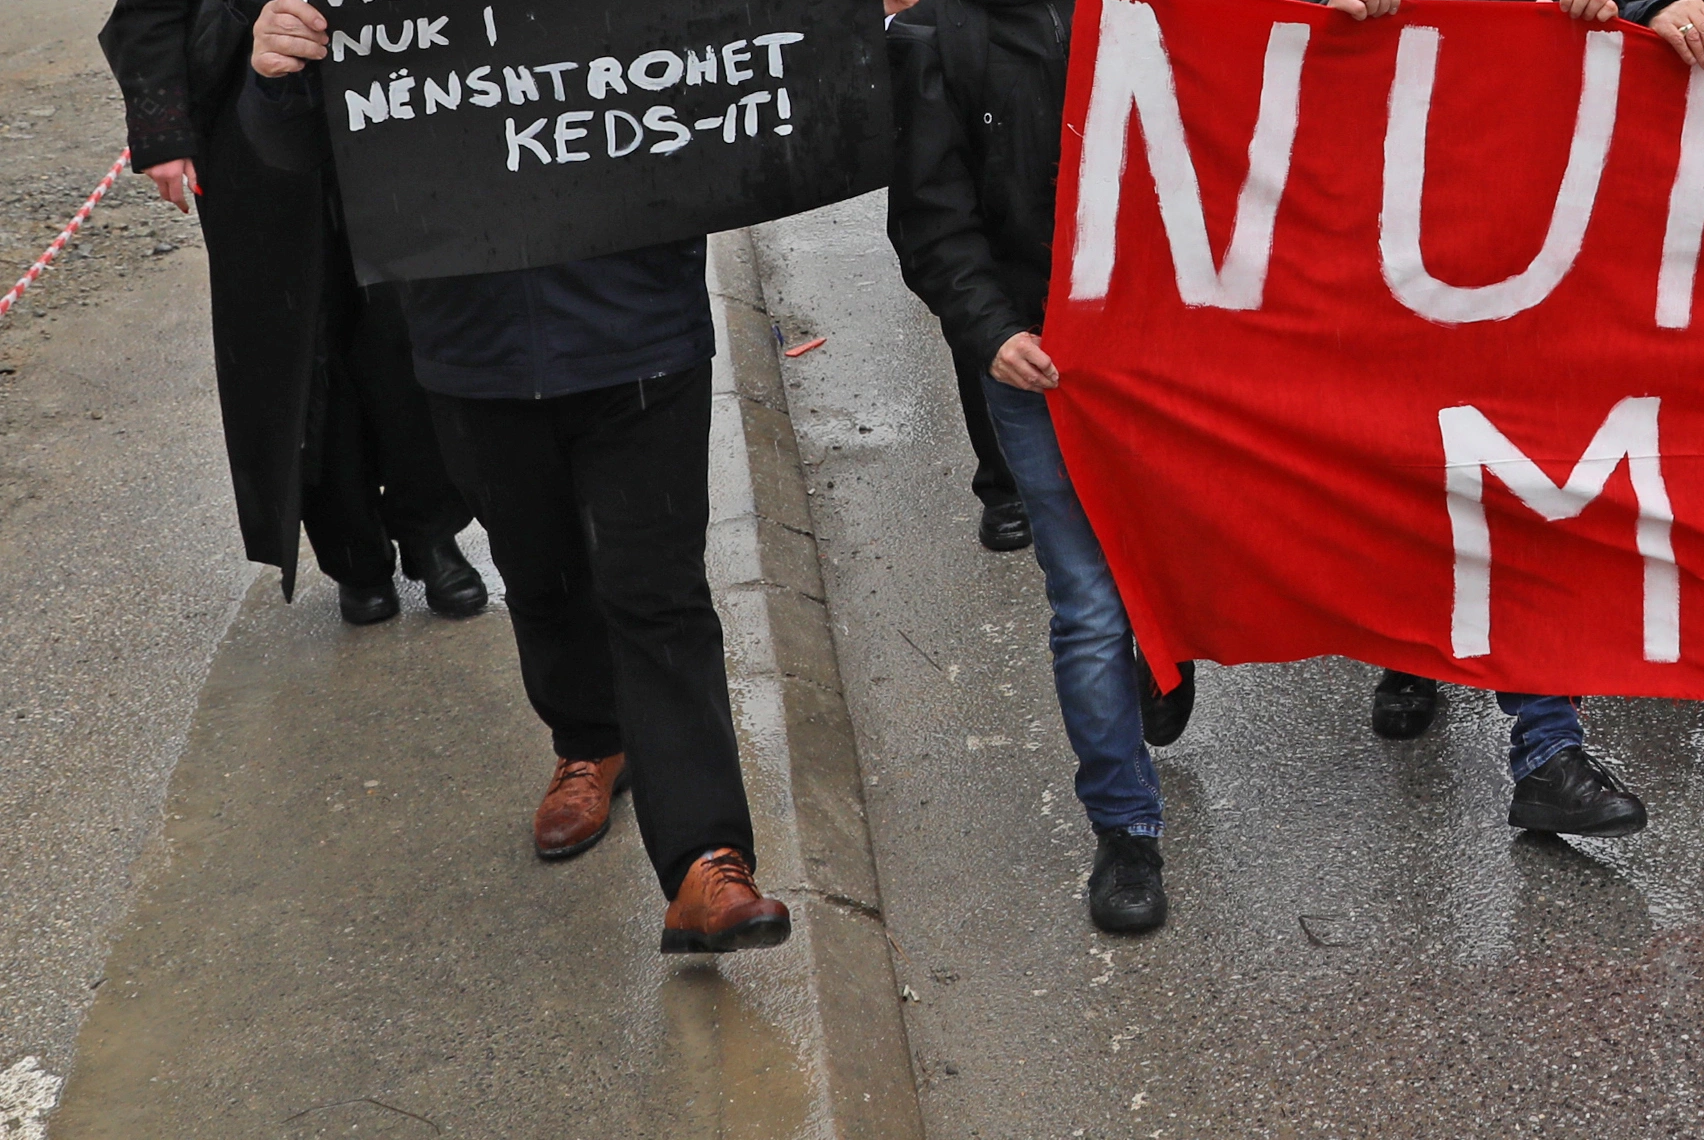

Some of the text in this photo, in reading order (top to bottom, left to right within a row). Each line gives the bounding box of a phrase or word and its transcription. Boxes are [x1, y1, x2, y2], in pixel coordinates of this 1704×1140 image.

[332, 6, 497, 61] NUK I
[344, 32, 804, 131] NËNSHTROHET
[505, 87, 794, 172] KEDS-IT!
